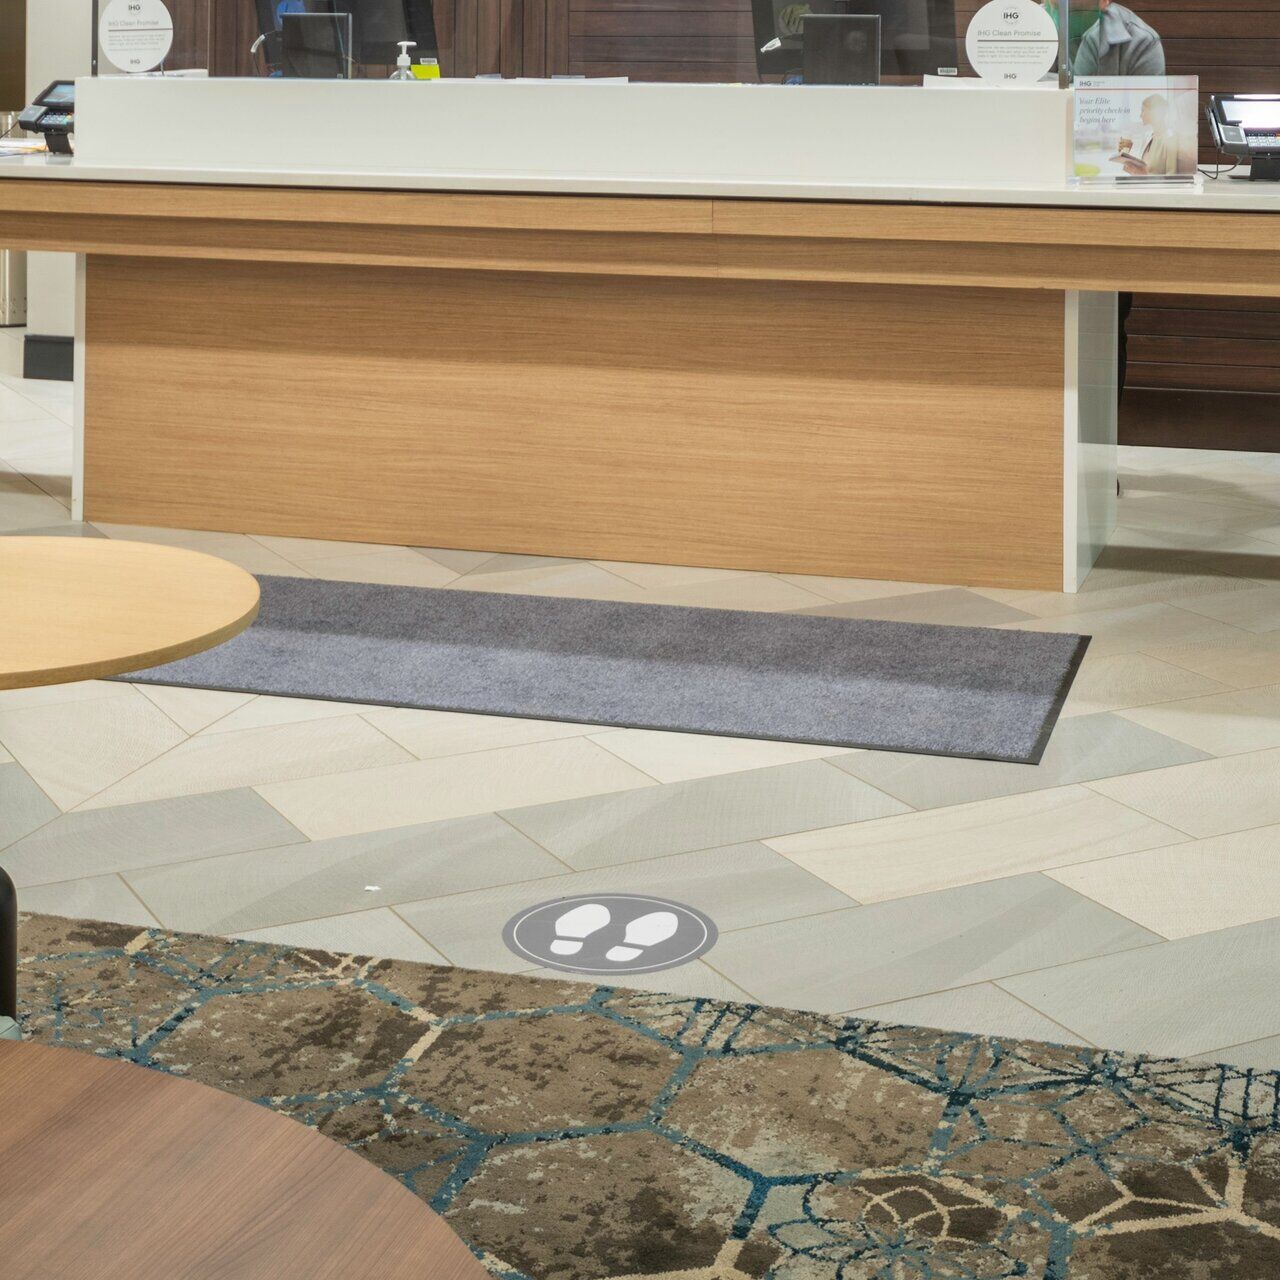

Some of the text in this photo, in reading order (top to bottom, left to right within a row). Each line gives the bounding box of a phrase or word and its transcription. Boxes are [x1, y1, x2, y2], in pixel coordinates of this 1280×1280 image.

[1003, 12, 1019, 20] IHG
[1079, 97, 1111, 105] Your Elite
[1079, 107, 1103, 116] priority
